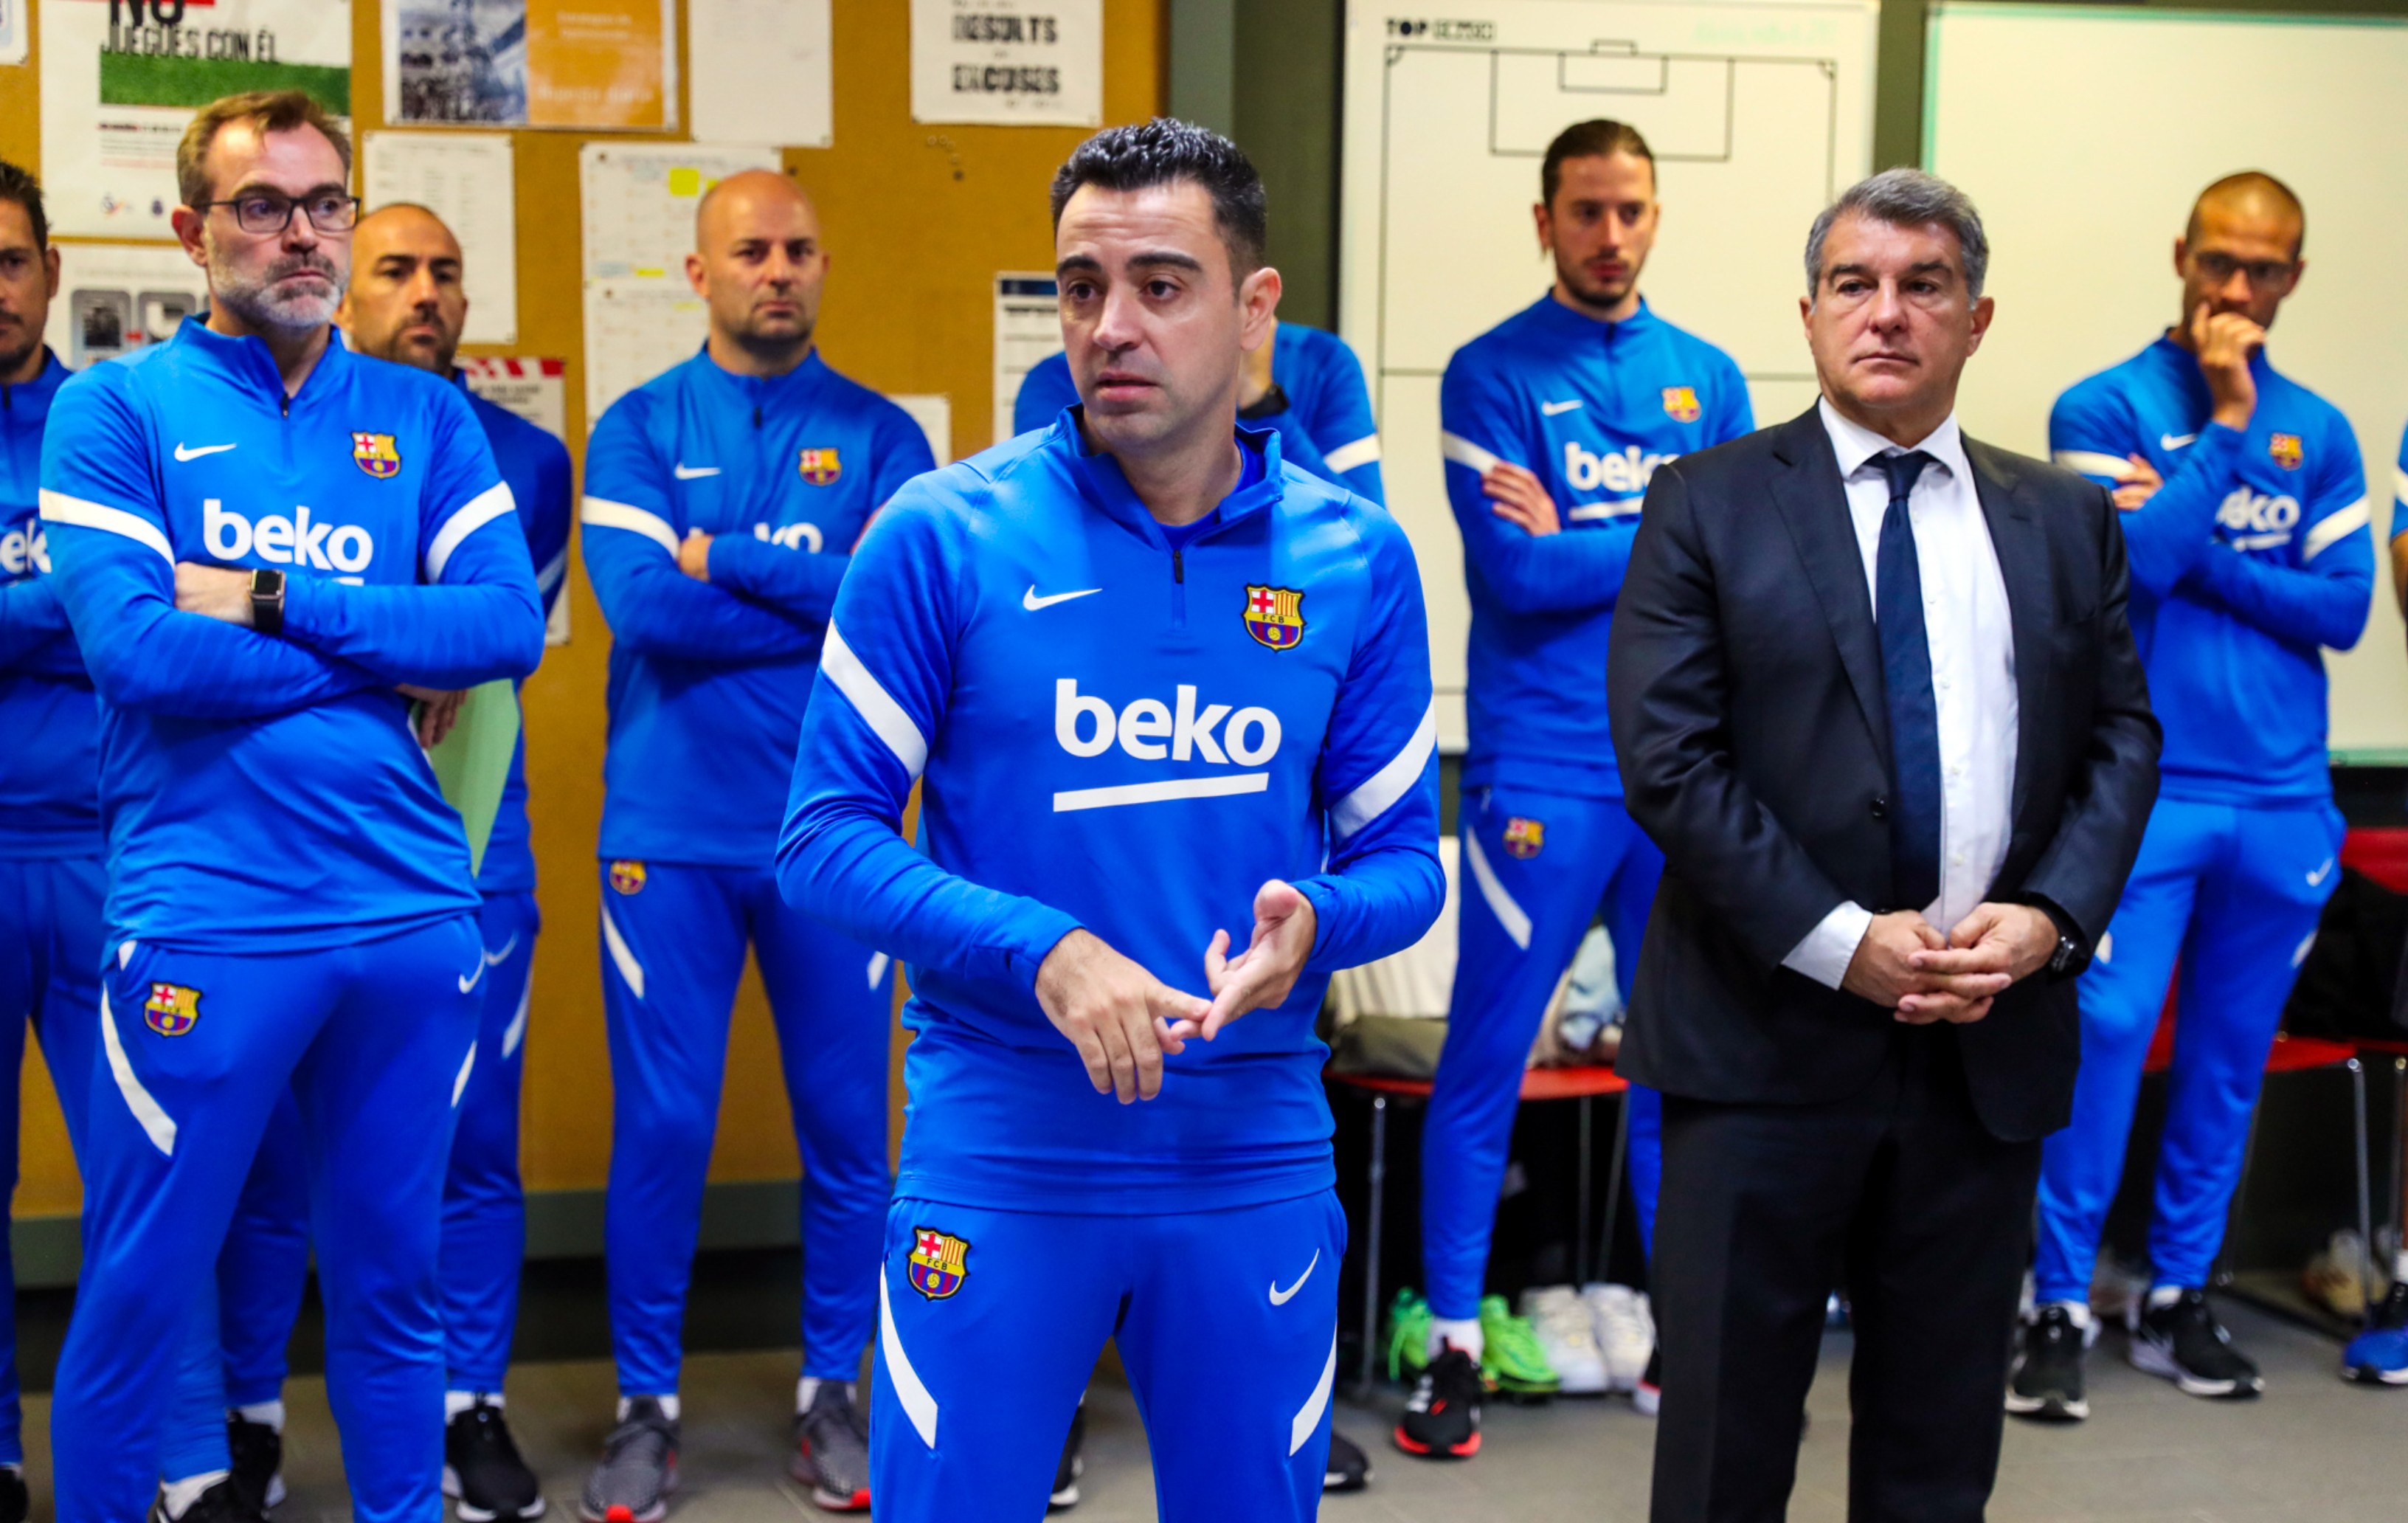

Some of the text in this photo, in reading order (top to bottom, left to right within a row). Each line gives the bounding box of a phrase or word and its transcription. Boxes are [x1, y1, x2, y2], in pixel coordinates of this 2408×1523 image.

[953, 13, 1057, 44] RESULTS
[1565, 441, 1681, 492] bek
[204, 499, 373, 573] beko
[1055, 679, 1281, 766] beko
